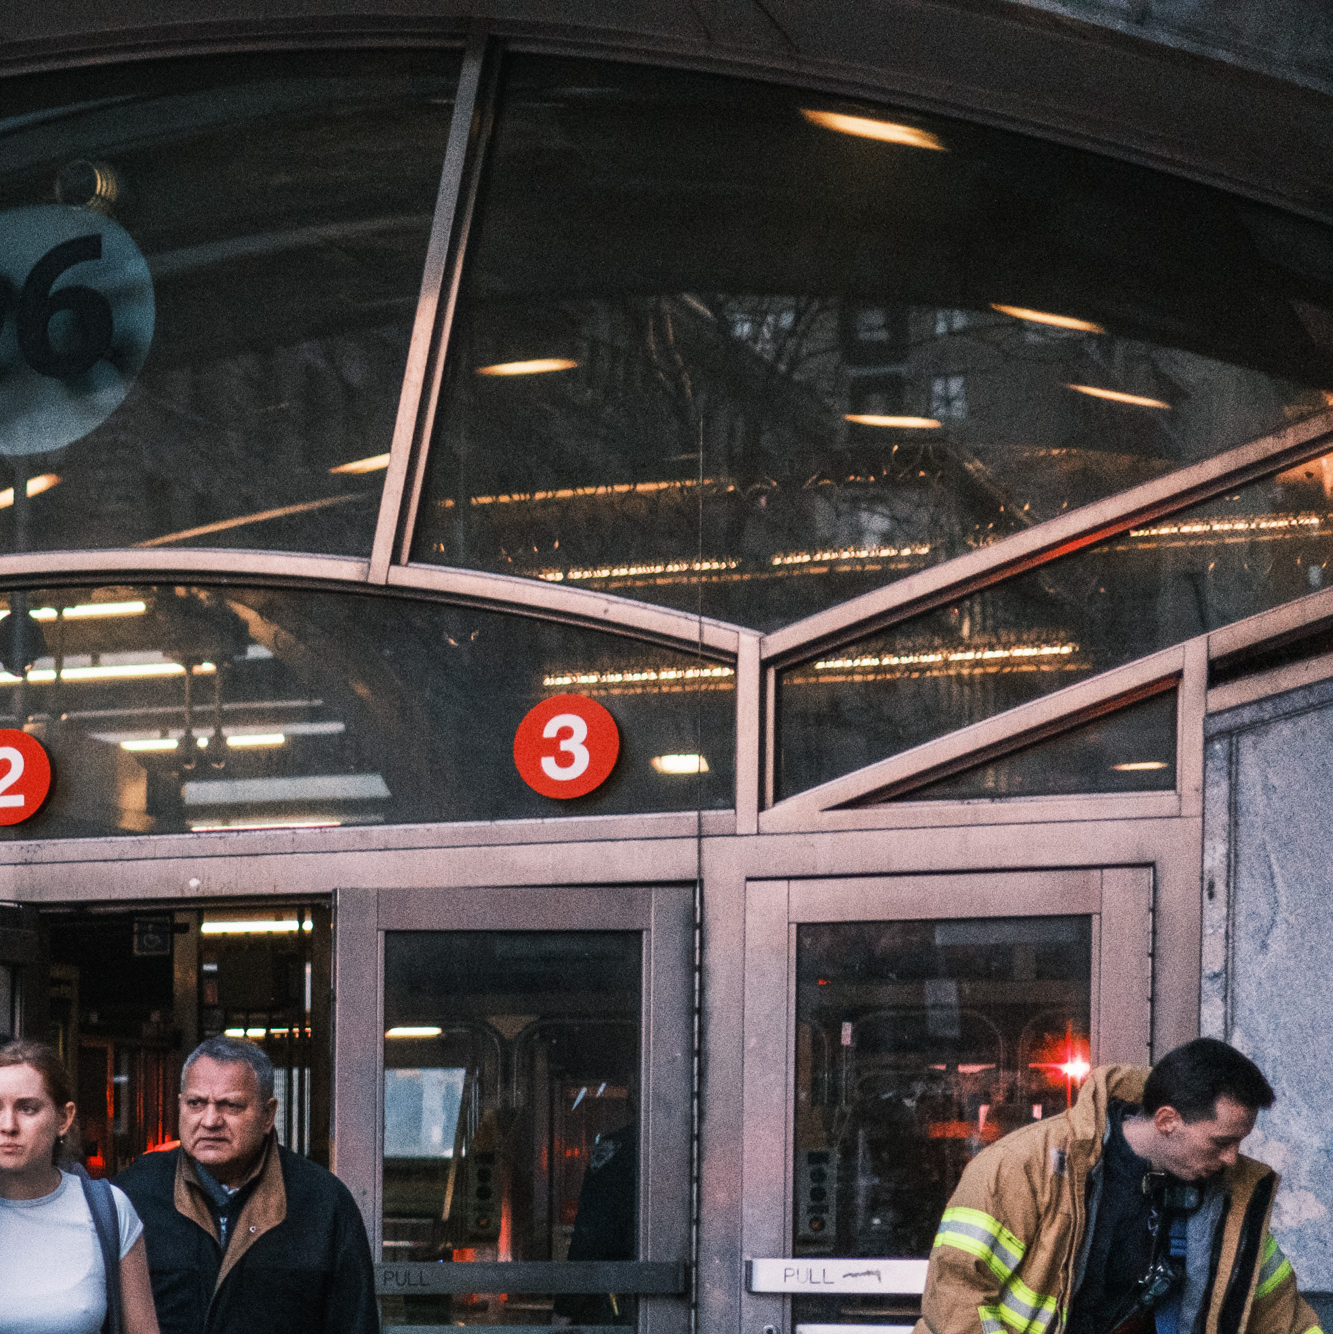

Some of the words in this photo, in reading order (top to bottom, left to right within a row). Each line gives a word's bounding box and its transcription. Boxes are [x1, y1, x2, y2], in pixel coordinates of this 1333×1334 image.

[540, 713, 590, 782] 3
[383, 1270, 430, 1287] PULL
[783, 1267, 835, 1285] PULL
